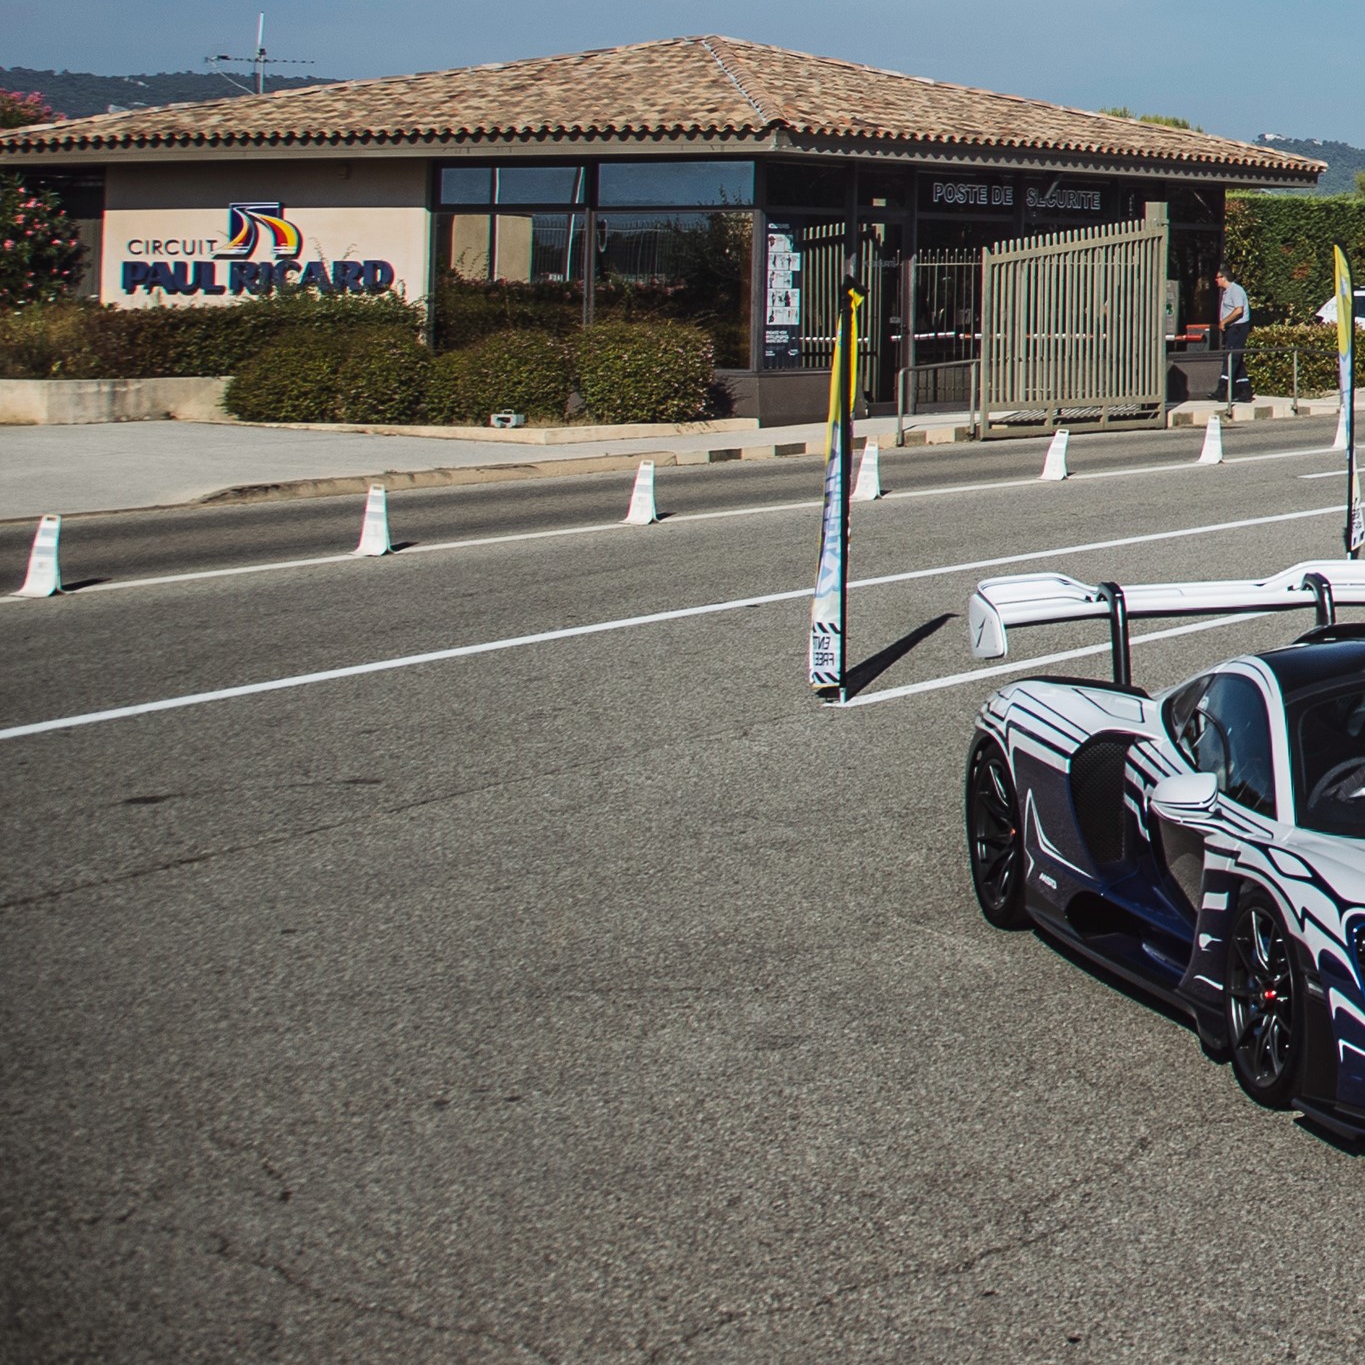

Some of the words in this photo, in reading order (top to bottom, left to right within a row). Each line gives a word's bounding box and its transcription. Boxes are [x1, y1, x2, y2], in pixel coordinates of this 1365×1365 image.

[933, 182, 988, 205] POSTE
[992, 186, 1013, 206] DE
[127, 239, 218, 256] CIRCUIT
[122, 260, 226, 295] PAUL
[229, 258, 395, 295] RICARD
